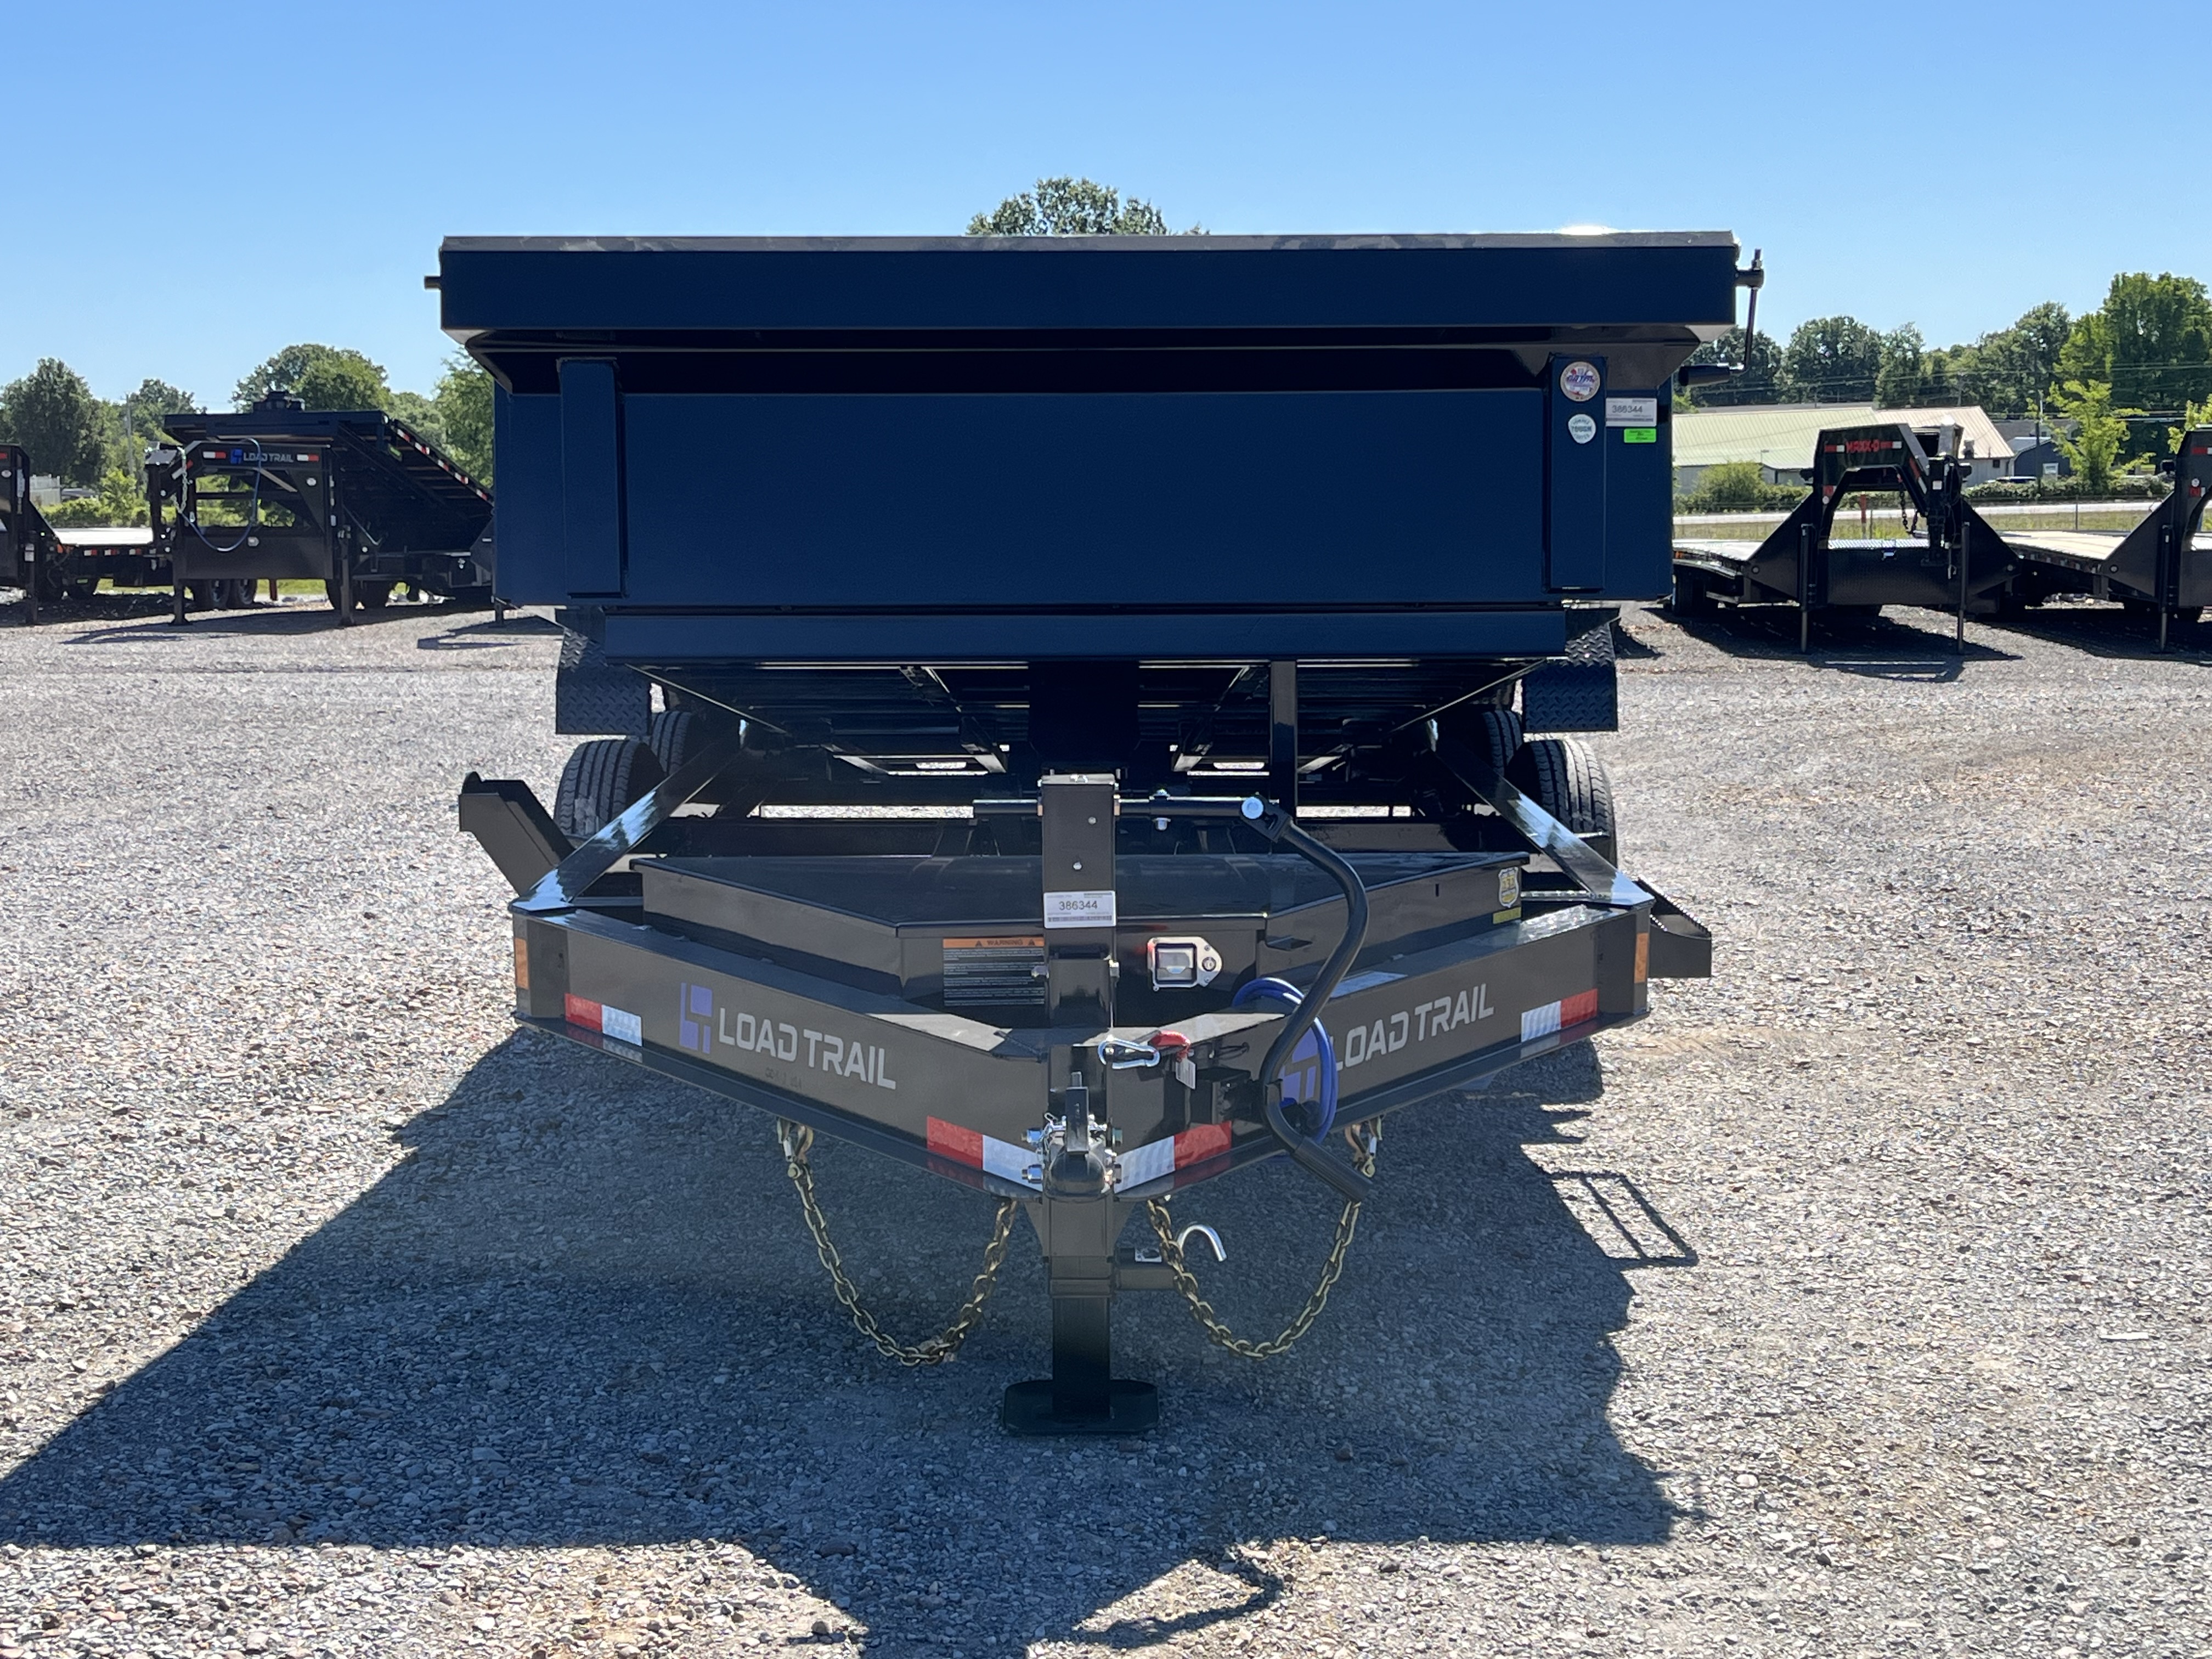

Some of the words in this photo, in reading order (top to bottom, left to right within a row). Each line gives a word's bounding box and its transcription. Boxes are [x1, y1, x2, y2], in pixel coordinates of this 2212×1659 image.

[243, 452, 268, 462] LOAD
[268, 453, 294, 463] TRAIL
[1059, 900, 1098, 911] 386344
[1414, 983, 1494, 1042] TRAIL
[719, 1007, 798, 1062] LOAD
[803, 1028, 896, 1090] TRAIL
